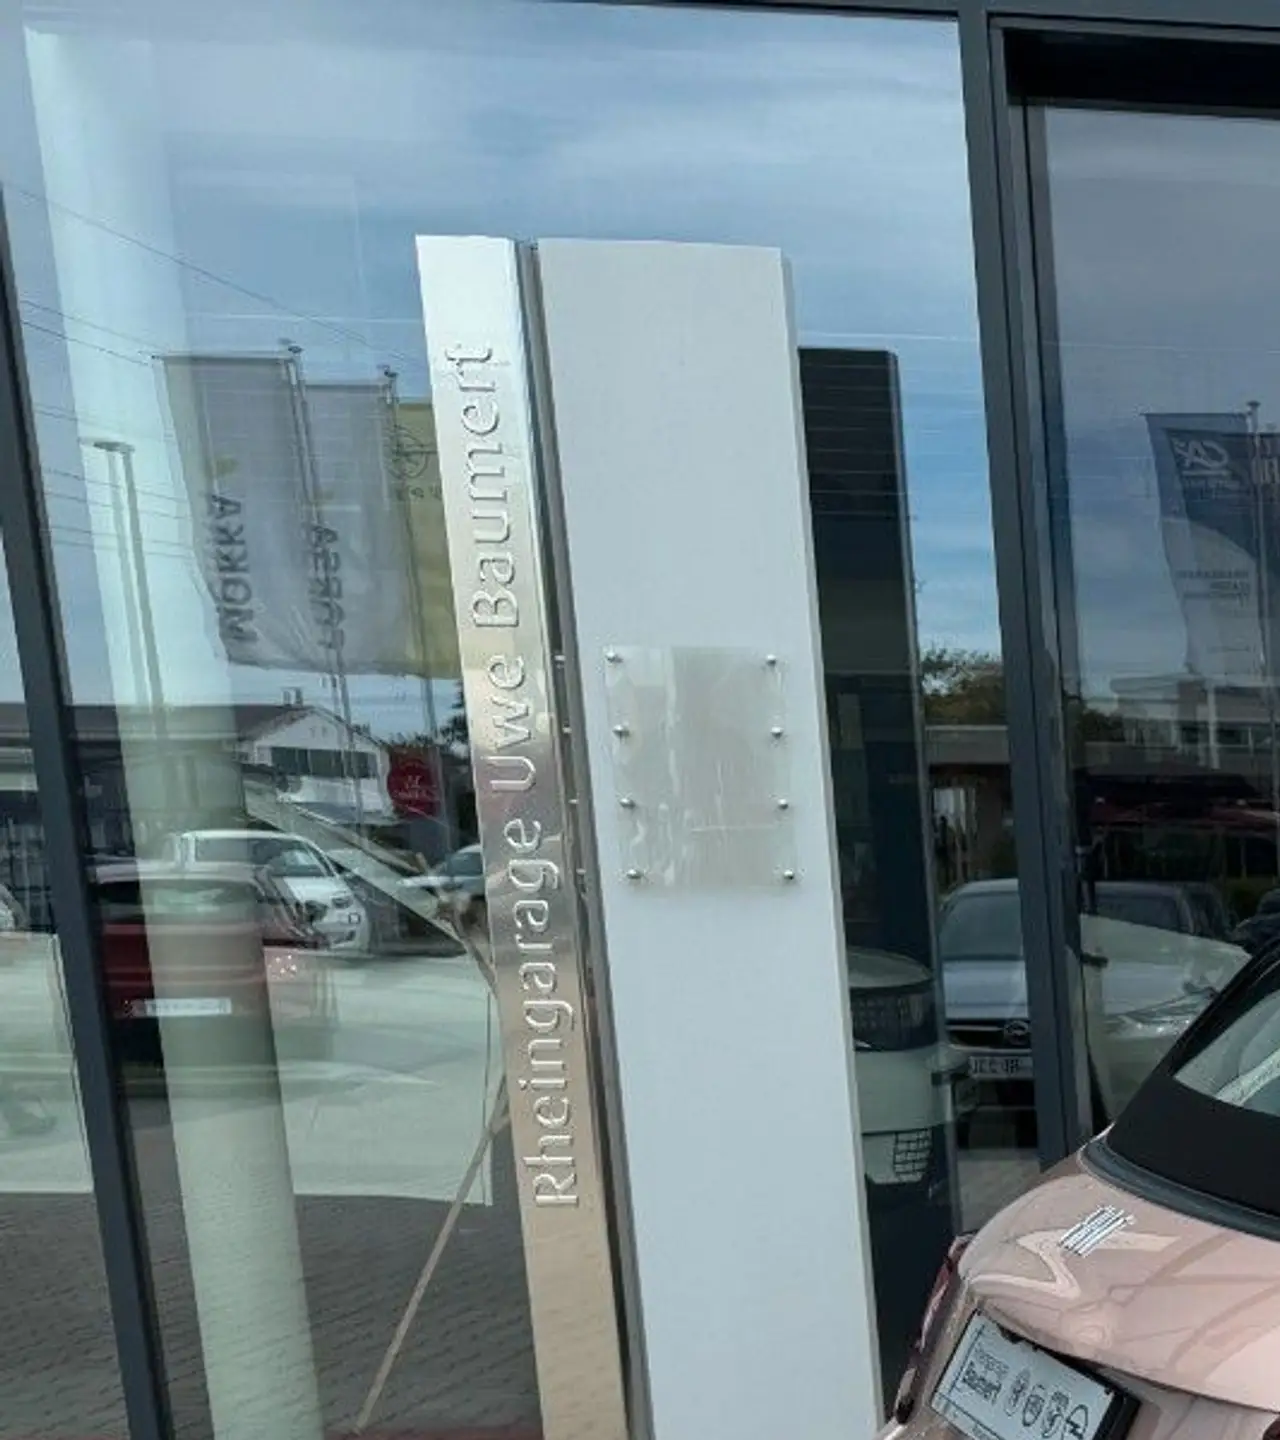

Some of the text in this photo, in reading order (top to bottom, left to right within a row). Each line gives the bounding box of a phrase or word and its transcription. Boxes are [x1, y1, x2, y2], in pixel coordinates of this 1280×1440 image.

[445, 344, 580, 1208] Rheingarage Uwe Baumert
